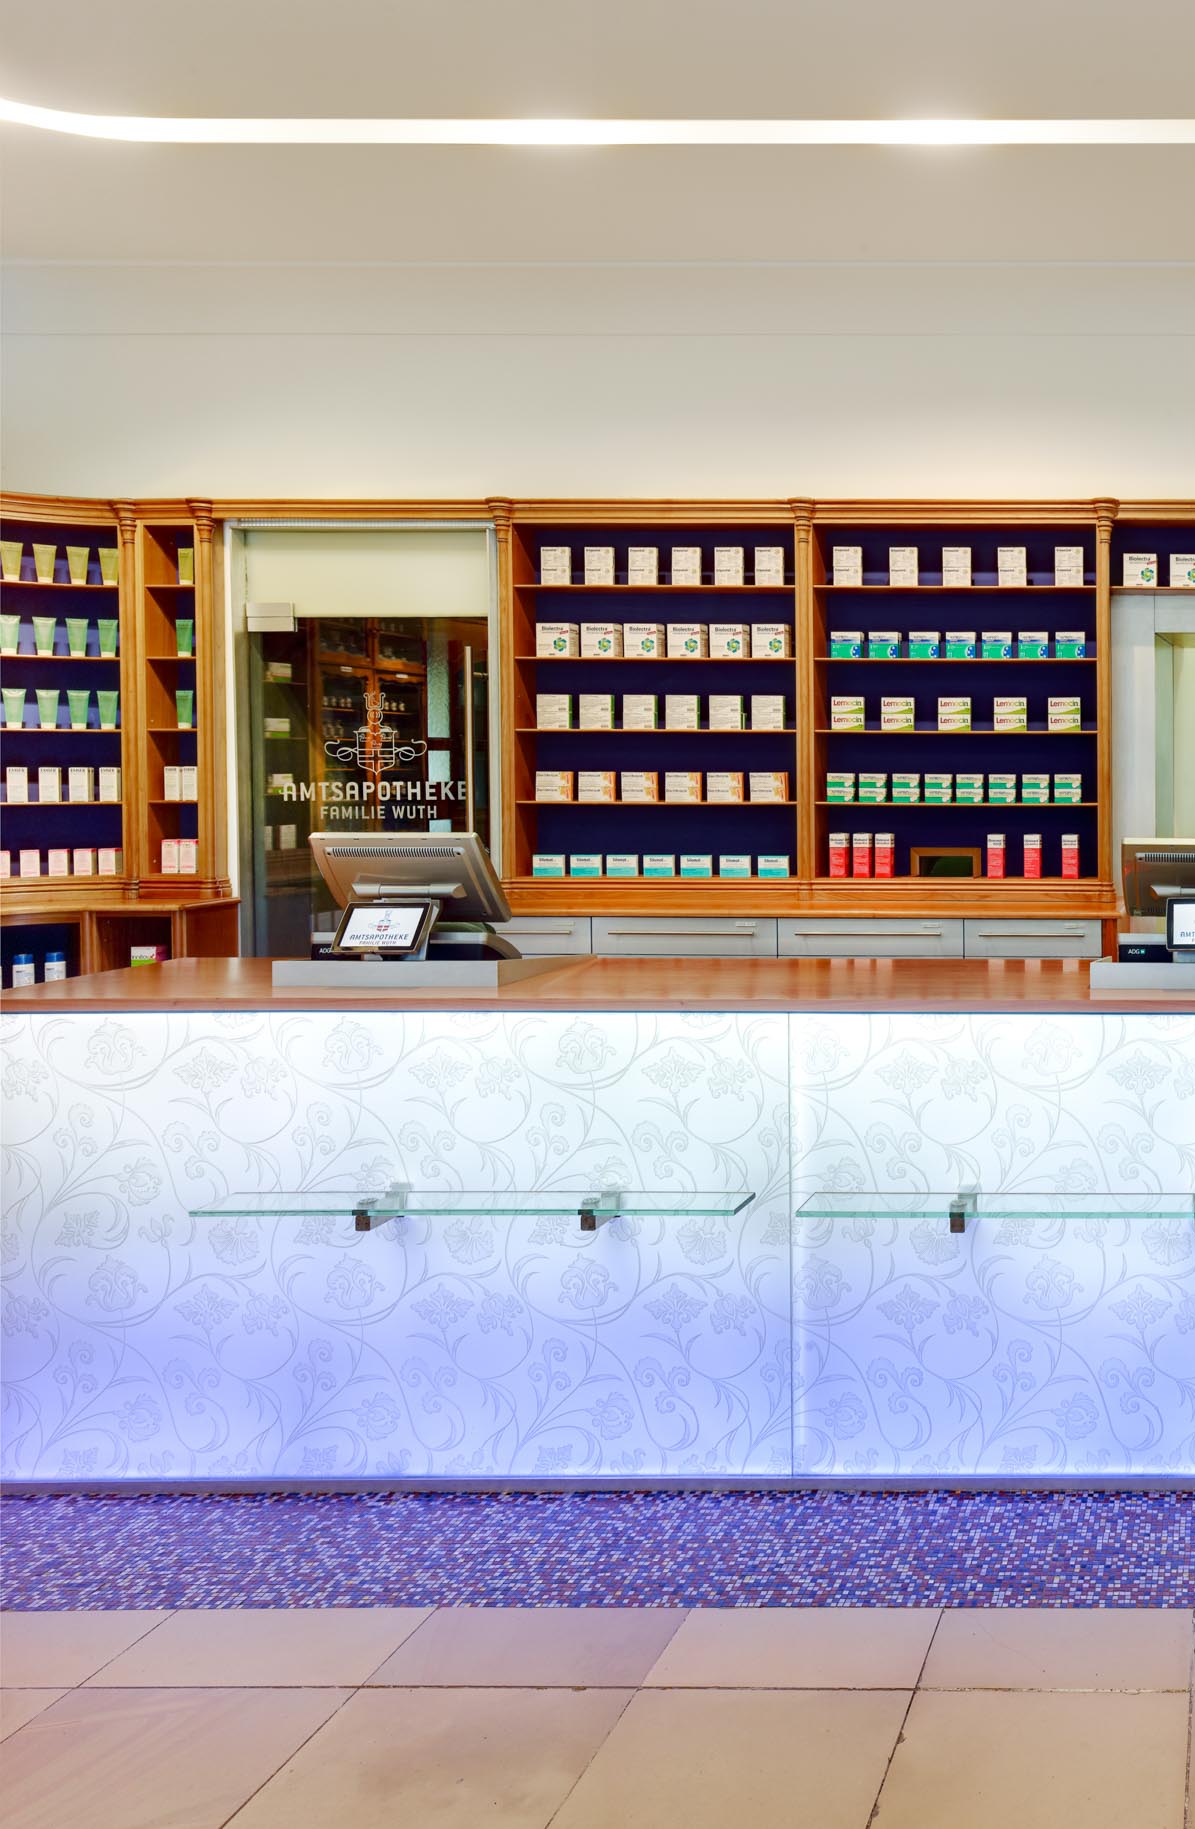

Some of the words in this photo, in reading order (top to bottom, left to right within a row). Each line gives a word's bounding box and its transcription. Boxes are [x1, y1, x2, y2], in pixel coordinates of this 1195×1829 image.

[833, 699, 862, 707] Lemocin
[883, 700, 912, 708] Lemocin
[940, 700, 969, 708] Lemocin
[996, 700, 1025, 708] Lemocin
[1050, 700, 1079, 708] Lemocin
[833, 716, 862, 724] Lemocin
[883, 716, 912, 724] Lemocin
[940, 716, 969, 724] Lemocin
[996, 716, 1025, 724] Lemocin
[1050, 716, 1079, 724] Lemocin
[283, 781, 466, 801] AMTSAPOTHEKE
[320, 805, 385, 819] FAMILIE
[392, 805, 437, 819] WUTH
